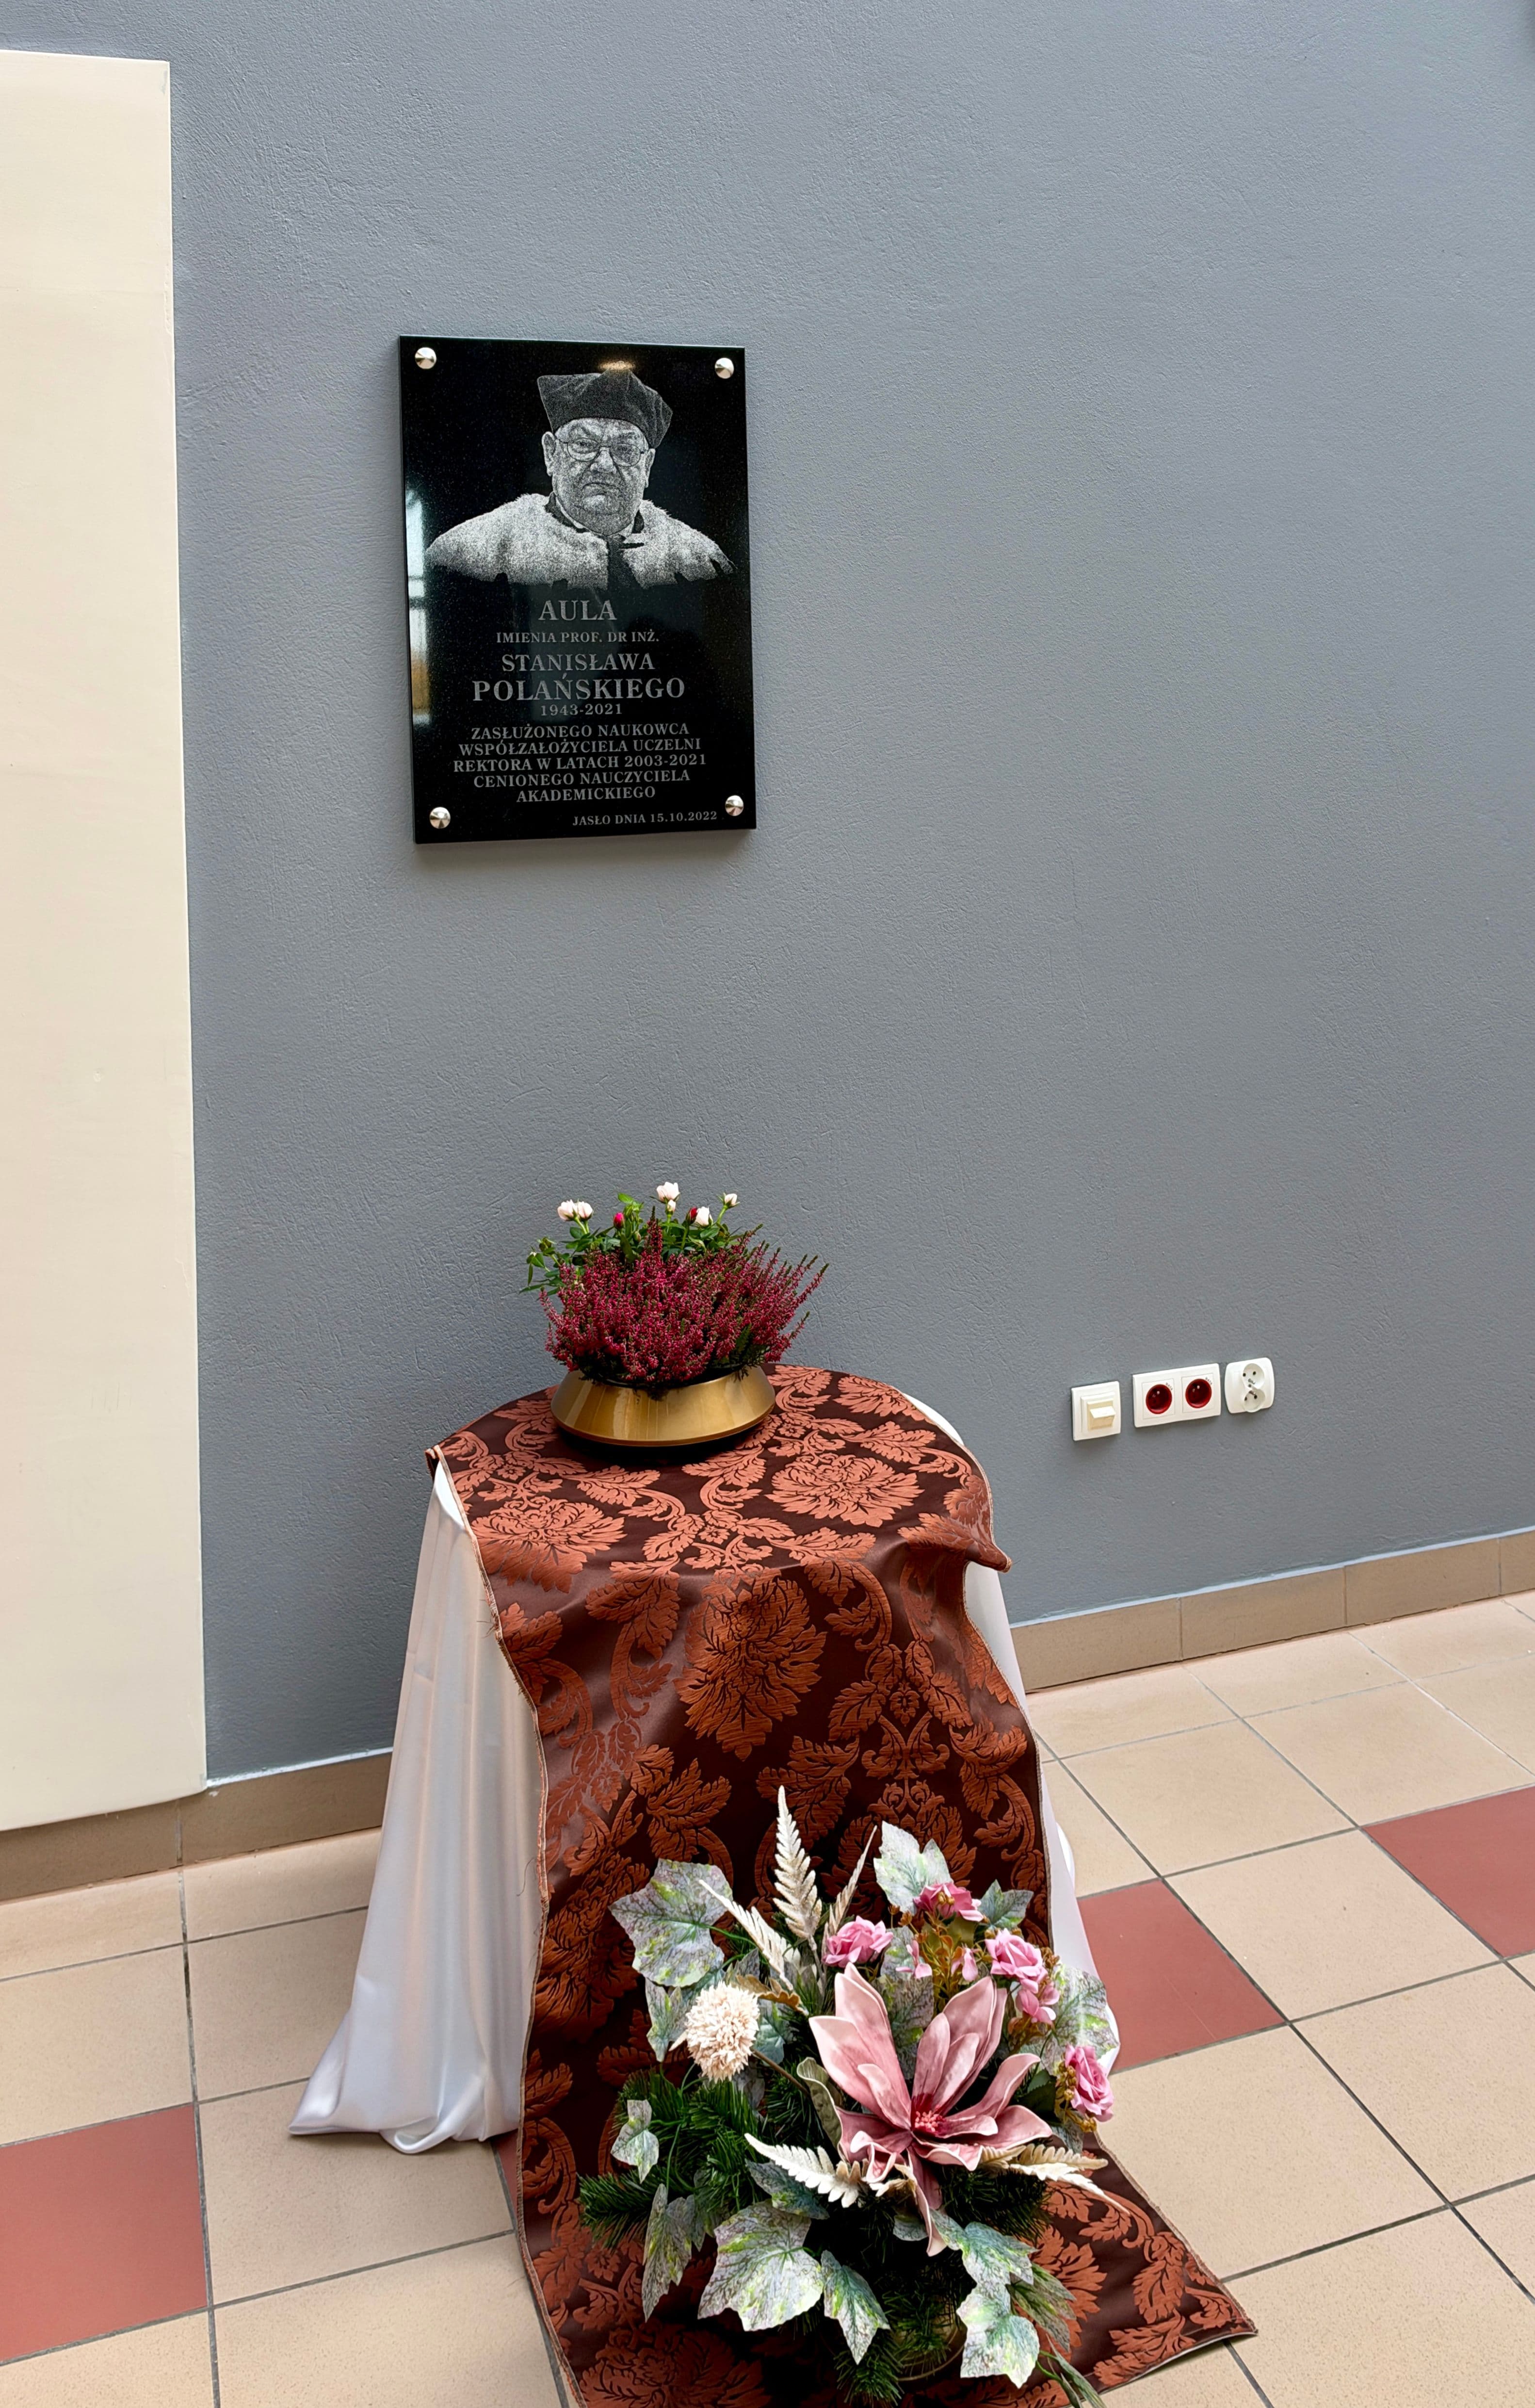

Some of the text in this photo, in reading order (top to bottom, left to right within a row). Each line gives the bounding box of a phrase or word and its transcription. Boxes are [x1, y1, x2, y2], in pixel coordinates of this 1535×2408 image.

[538, 600, 617, 621] AULA
[496, 629, 659, 643] IMIENIA PROF. DR INŻ.
[502, 652, 656, 672] STANISŁAWA
[472, 673, 685, 701] POLAŃSKIEGO
[540, 703, 623, 716] 1943-2021
[471, 723, 690, 740] ZASŁUŻONEGO NAUKOWCA
[459, 738, 701, 756] WSPÓŁZAŁOŻYCIELA UCZELNI
[453, 754, 707, 773] REKTORA W LATACH 2003-2021
[473, 769, 691, 788] CENIONEGO NAUCZYCIELA
[517, 786, 656, 803] AKADEMICKIEGO
[572, 811, 718, 827] JASŁO DNIA 15.10.2022
